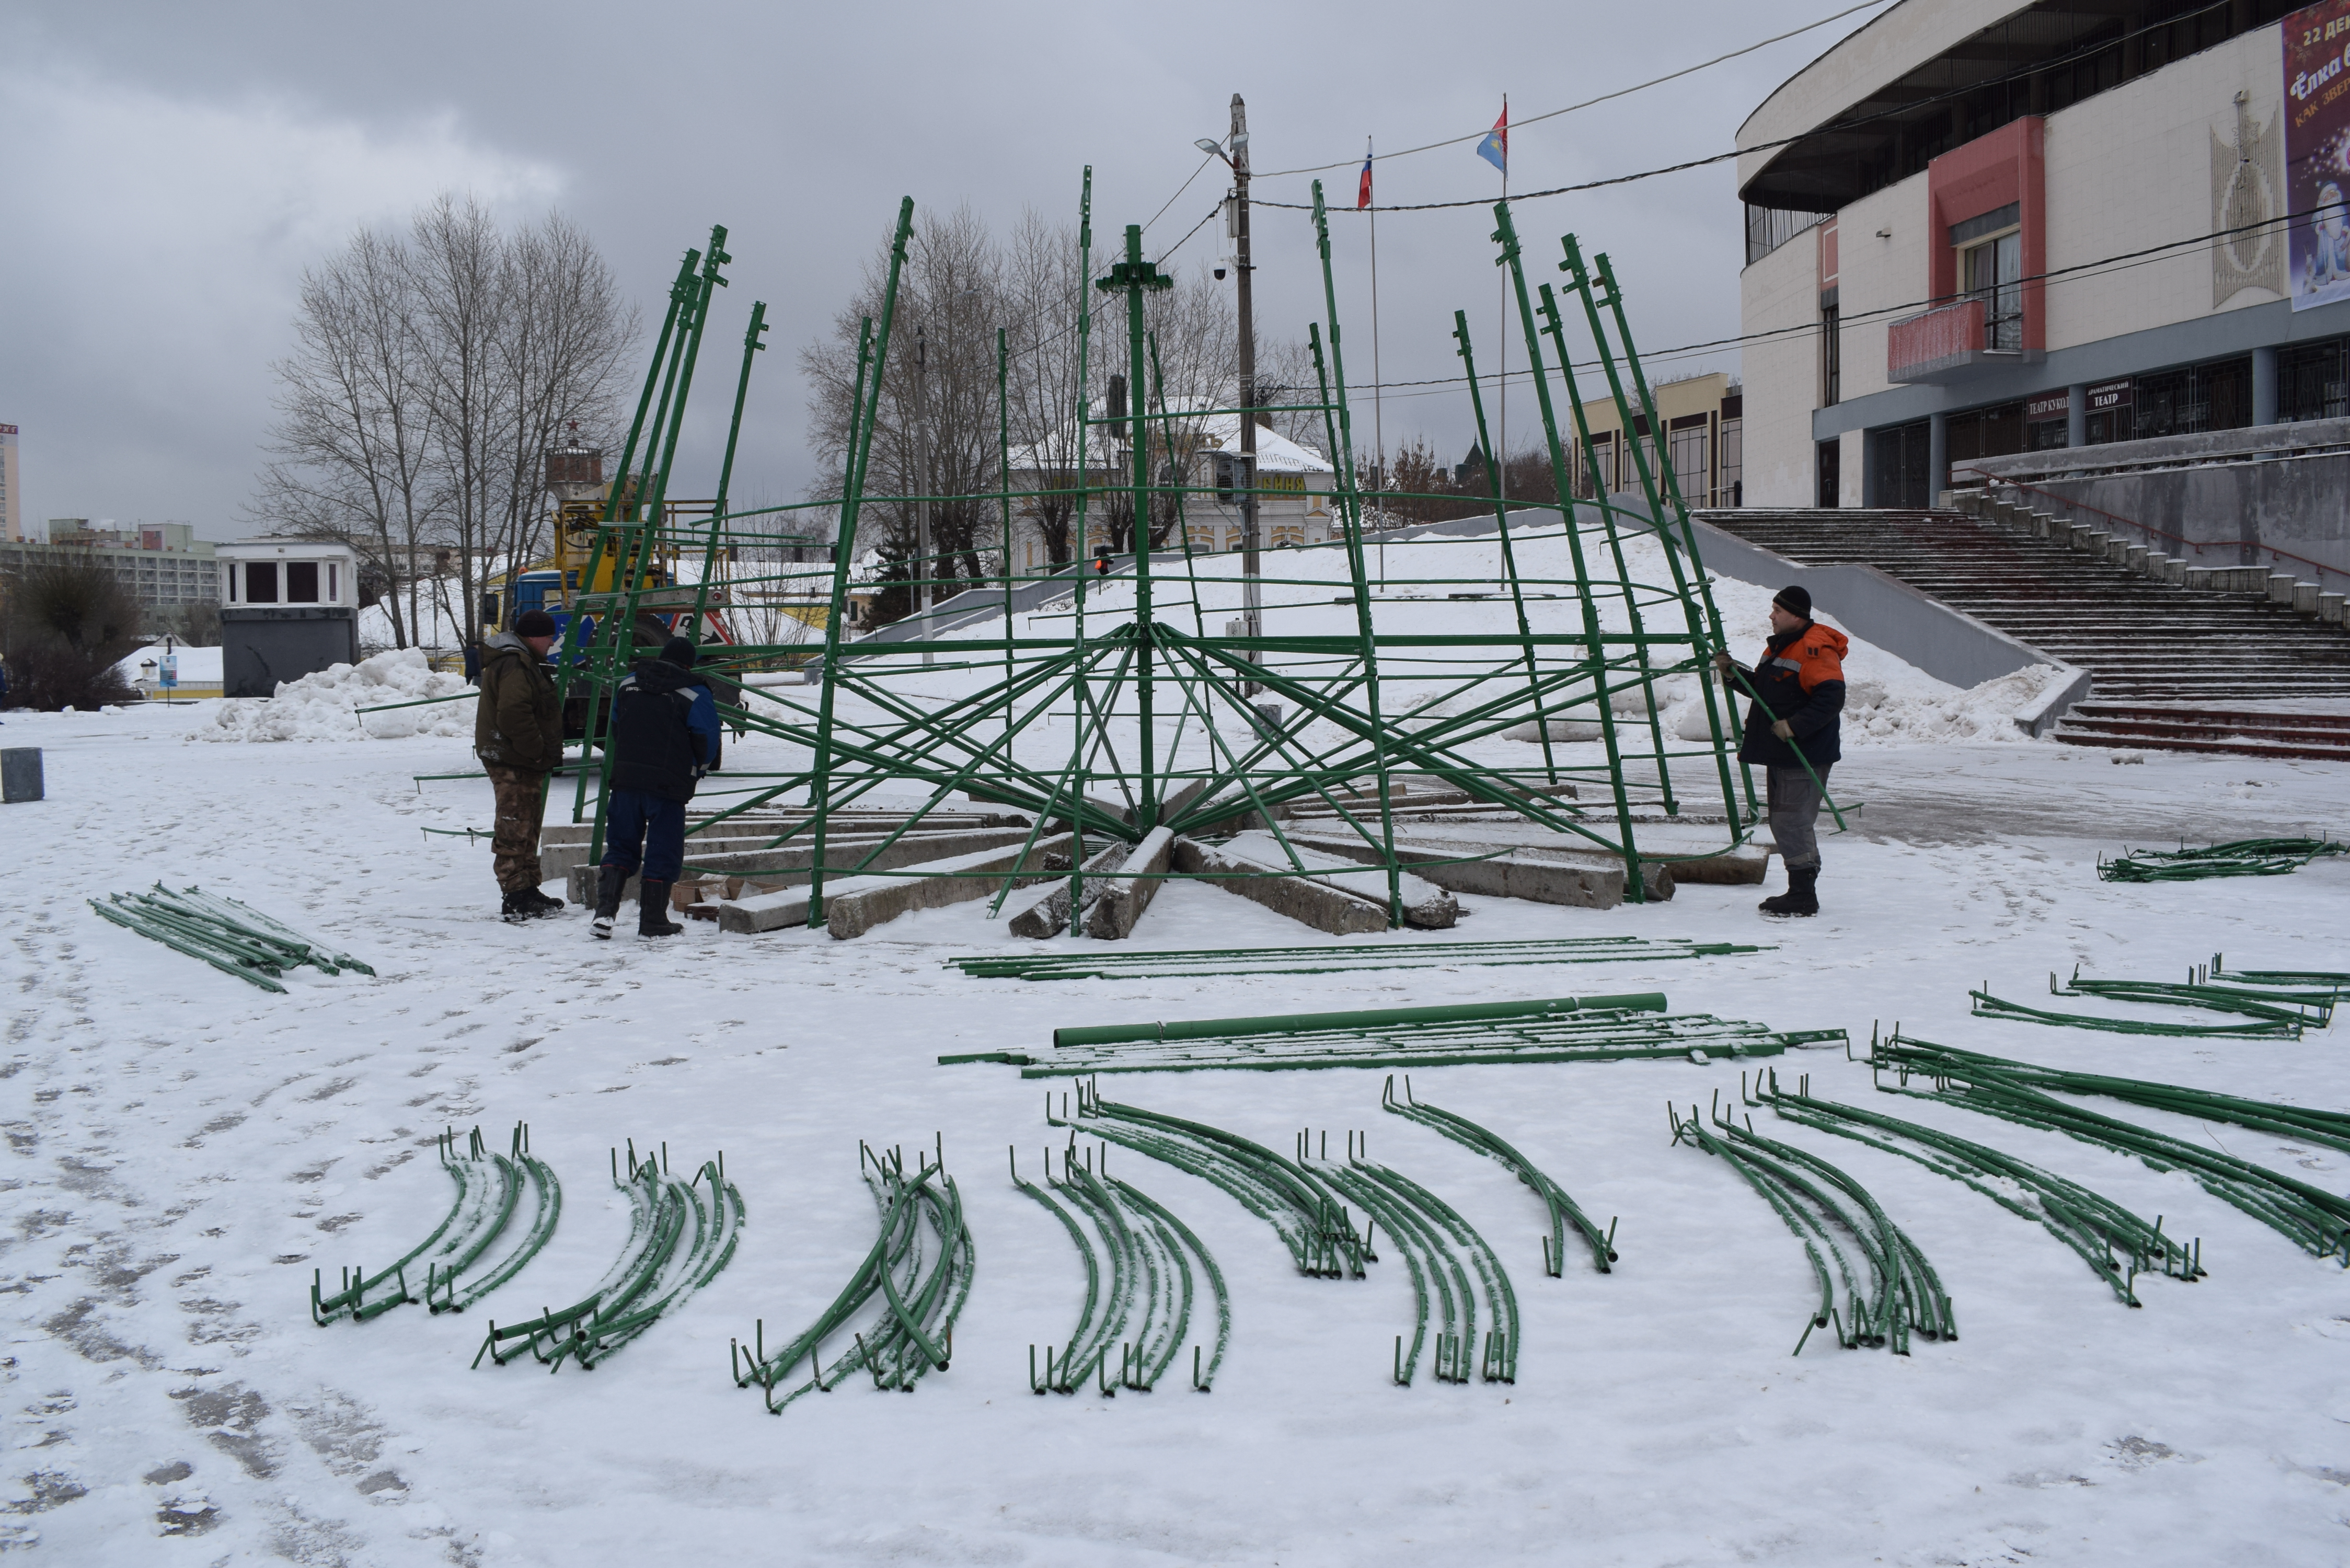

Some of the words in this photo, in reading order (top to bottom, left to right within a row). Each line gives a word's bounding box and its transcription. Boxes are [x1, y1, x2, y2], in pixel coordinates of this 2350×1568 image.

[2304, 27, 2321, 46] 22
[2290, 55, 2341, 100] Ёлка
[2295, 101, 2319, 128] КАК
[2088, 381, 2129, 396] ДРАМАТИЧЕСКИЙ
[2030, 401, 2047, 414] ТЕАТР
[2095, 393, 2118, 407] ТЕАТР
